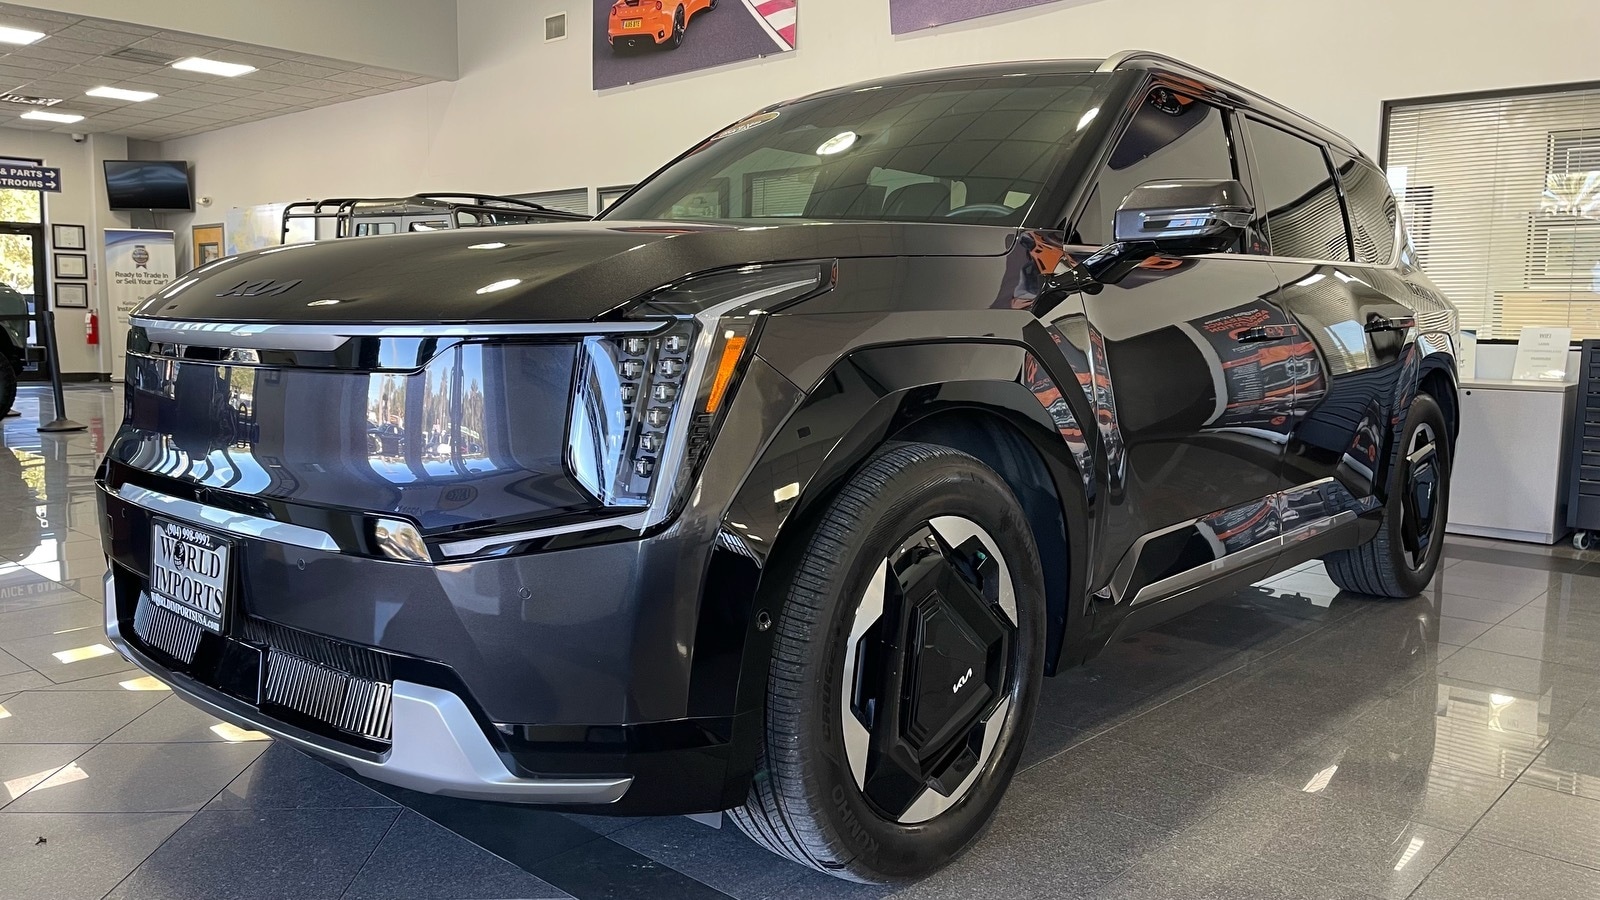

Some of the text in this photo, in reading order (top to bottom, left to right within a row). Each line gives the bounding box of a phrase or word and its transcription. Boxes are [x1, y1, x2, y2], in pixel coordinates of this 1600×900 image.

[0, 178, 43, 188] TROOMS
[10, 168, 43, 178] PARTS
[161, 535, 221, 579] WORLD
[155, 565, 223, 615] IMPORTS
[953, 667, 973, 693] KIA
